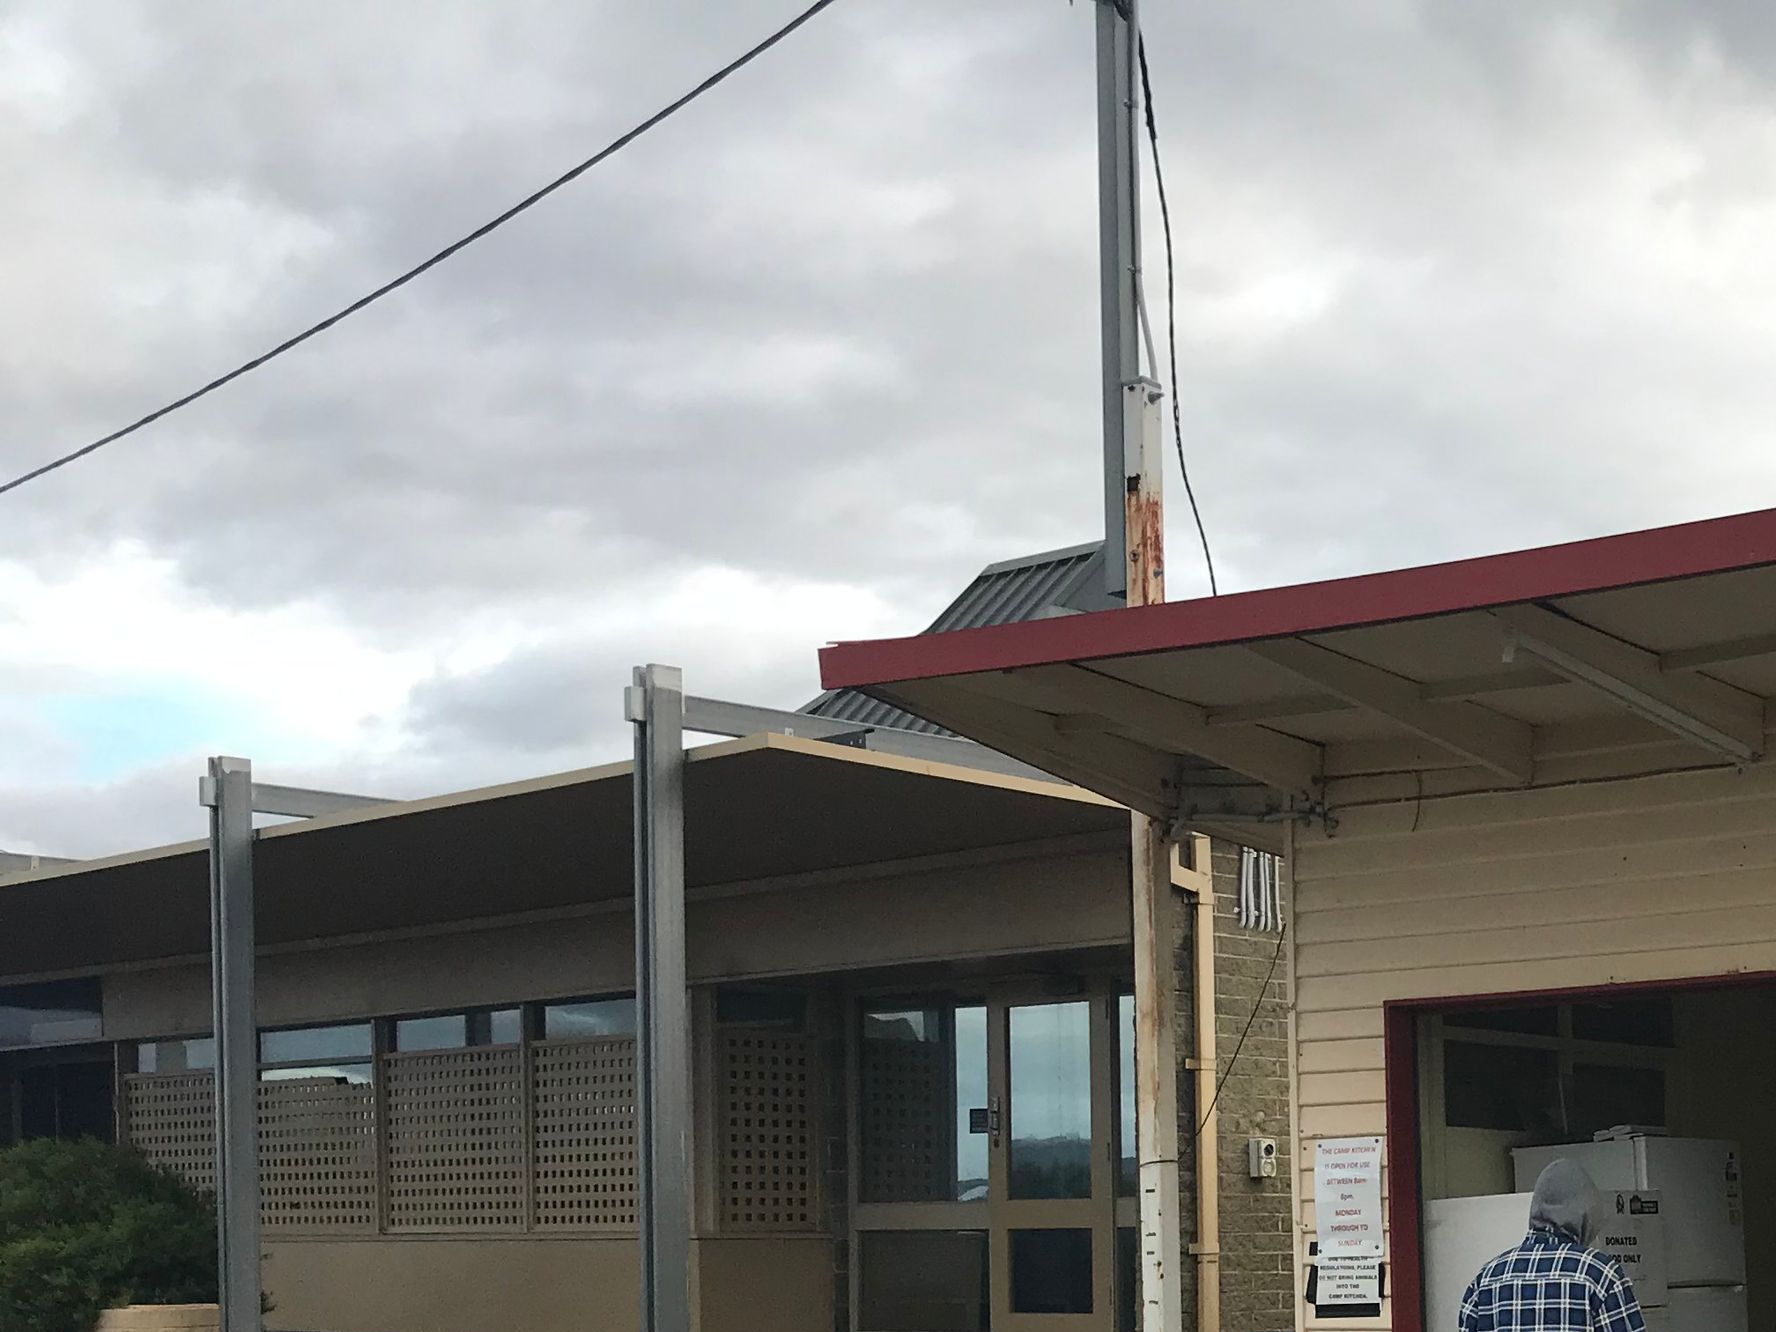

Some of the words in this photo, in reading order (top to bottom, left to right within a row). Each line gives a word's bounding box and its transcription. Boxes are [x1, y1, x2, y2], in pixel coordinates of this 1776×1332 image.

[1337, 1239, 1362, 1247] SUNDAY
[1605, 1236, 1638, 1246] DONATED
[1622, 1254, 1642, 1264] ONLY
